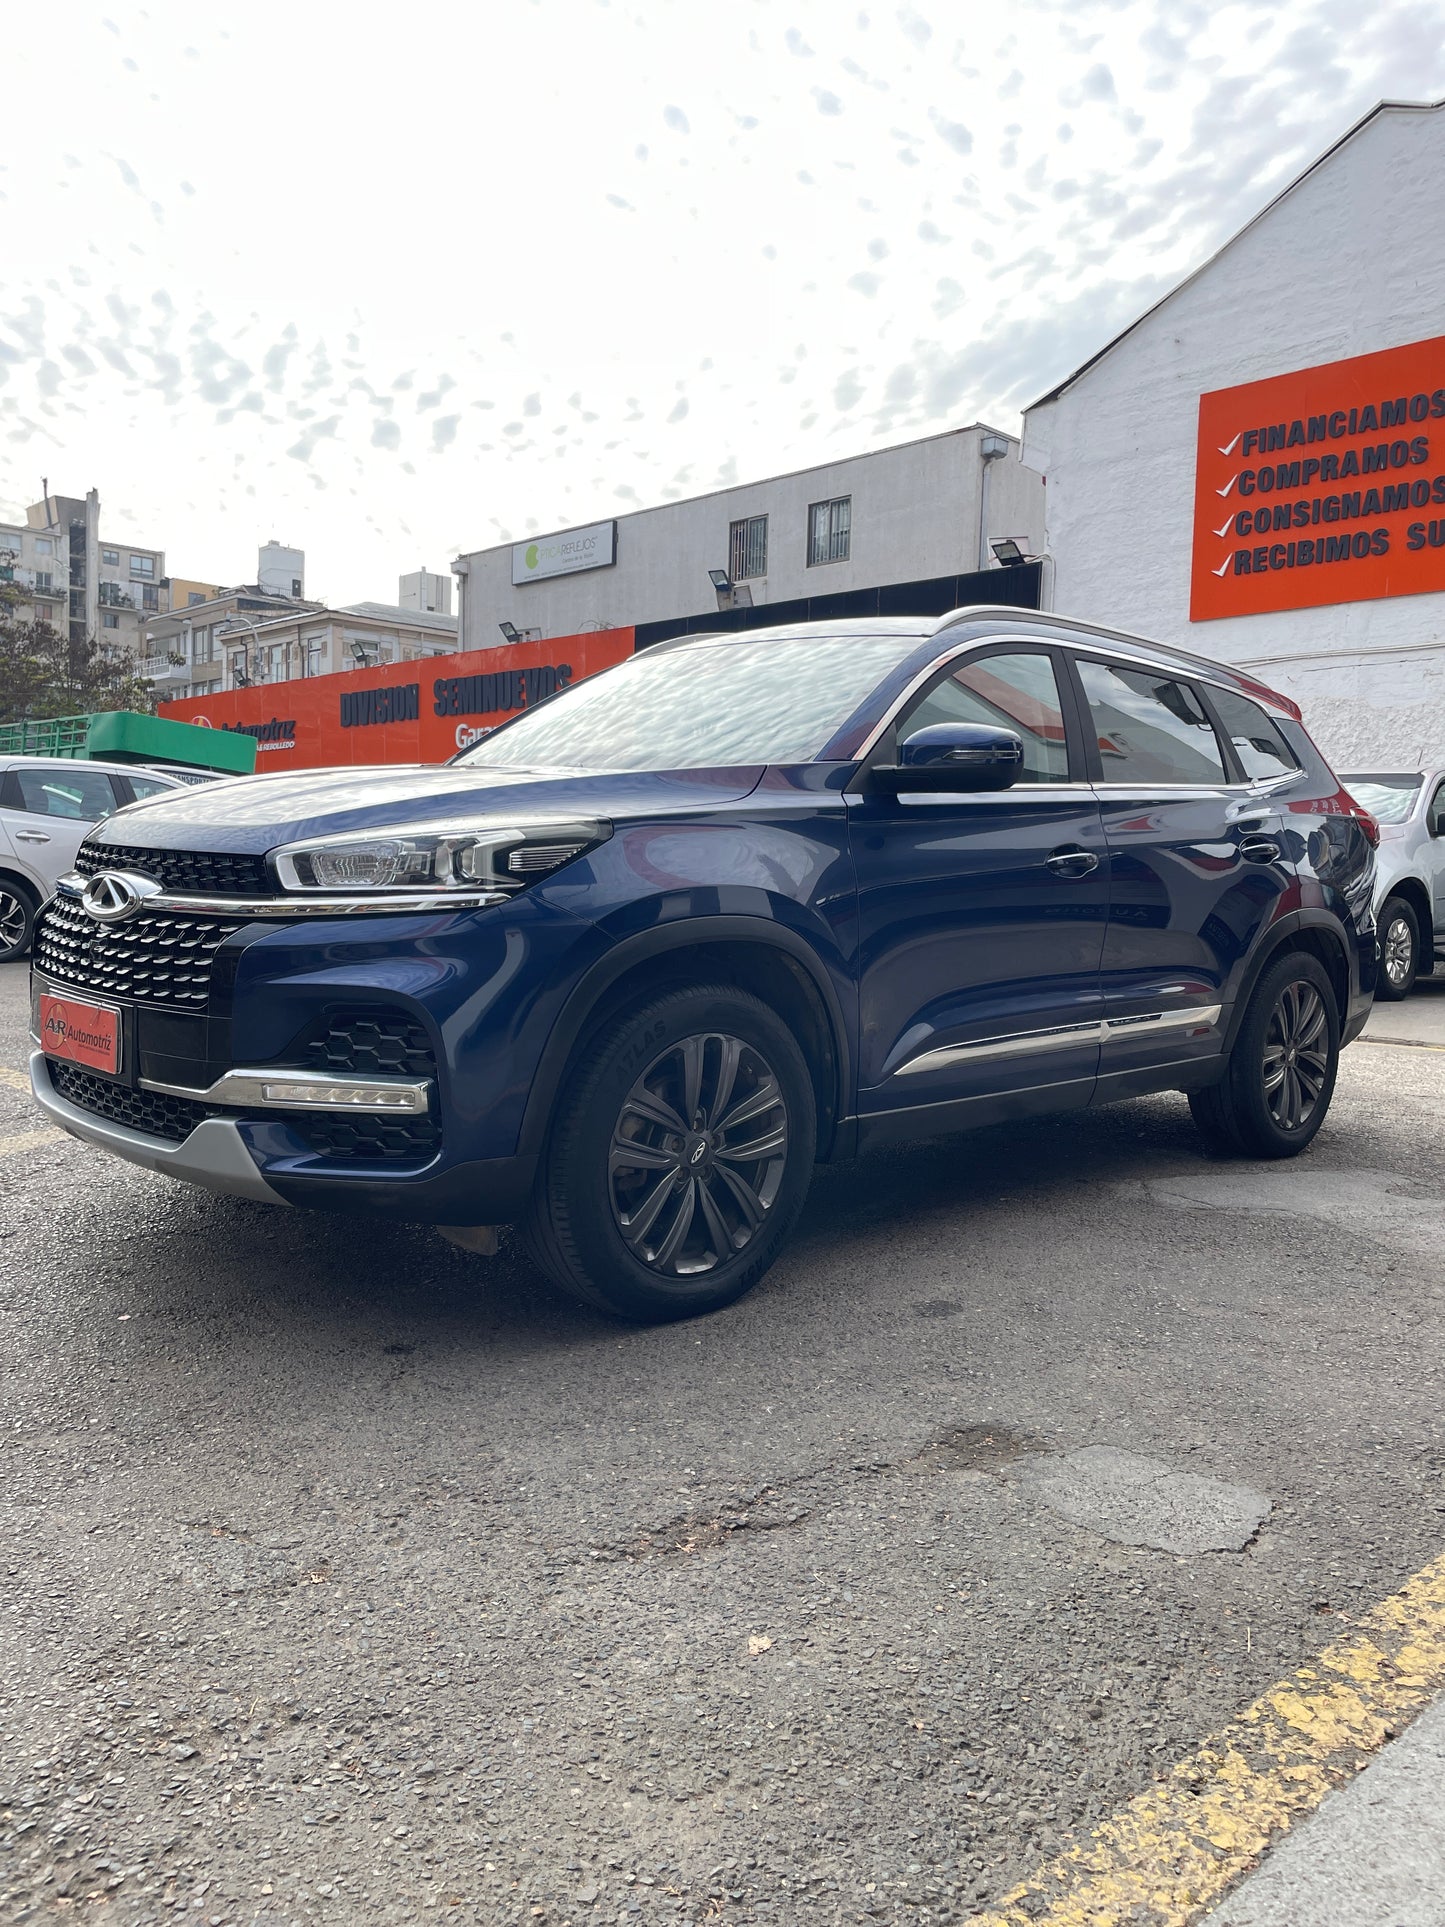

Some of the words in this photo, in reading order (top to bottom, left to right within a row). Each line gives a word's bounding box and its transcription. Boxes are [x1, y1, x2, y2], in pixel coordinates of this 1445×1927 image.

[1242, 389, 1445, 457] FINANCIAMOS
[1238, 436, 1430, 496] COMPRAMOS
[1235, 475, 1445, 537] CONSIGNAMOS
[1233, 528, 1390, 576] RECIBIMOS
[340, 683, 420, 728] DIVISION
[434, 664, 573, 717] SEMINUEVOS
[67, 1025, 112, 1050] Automotriz
